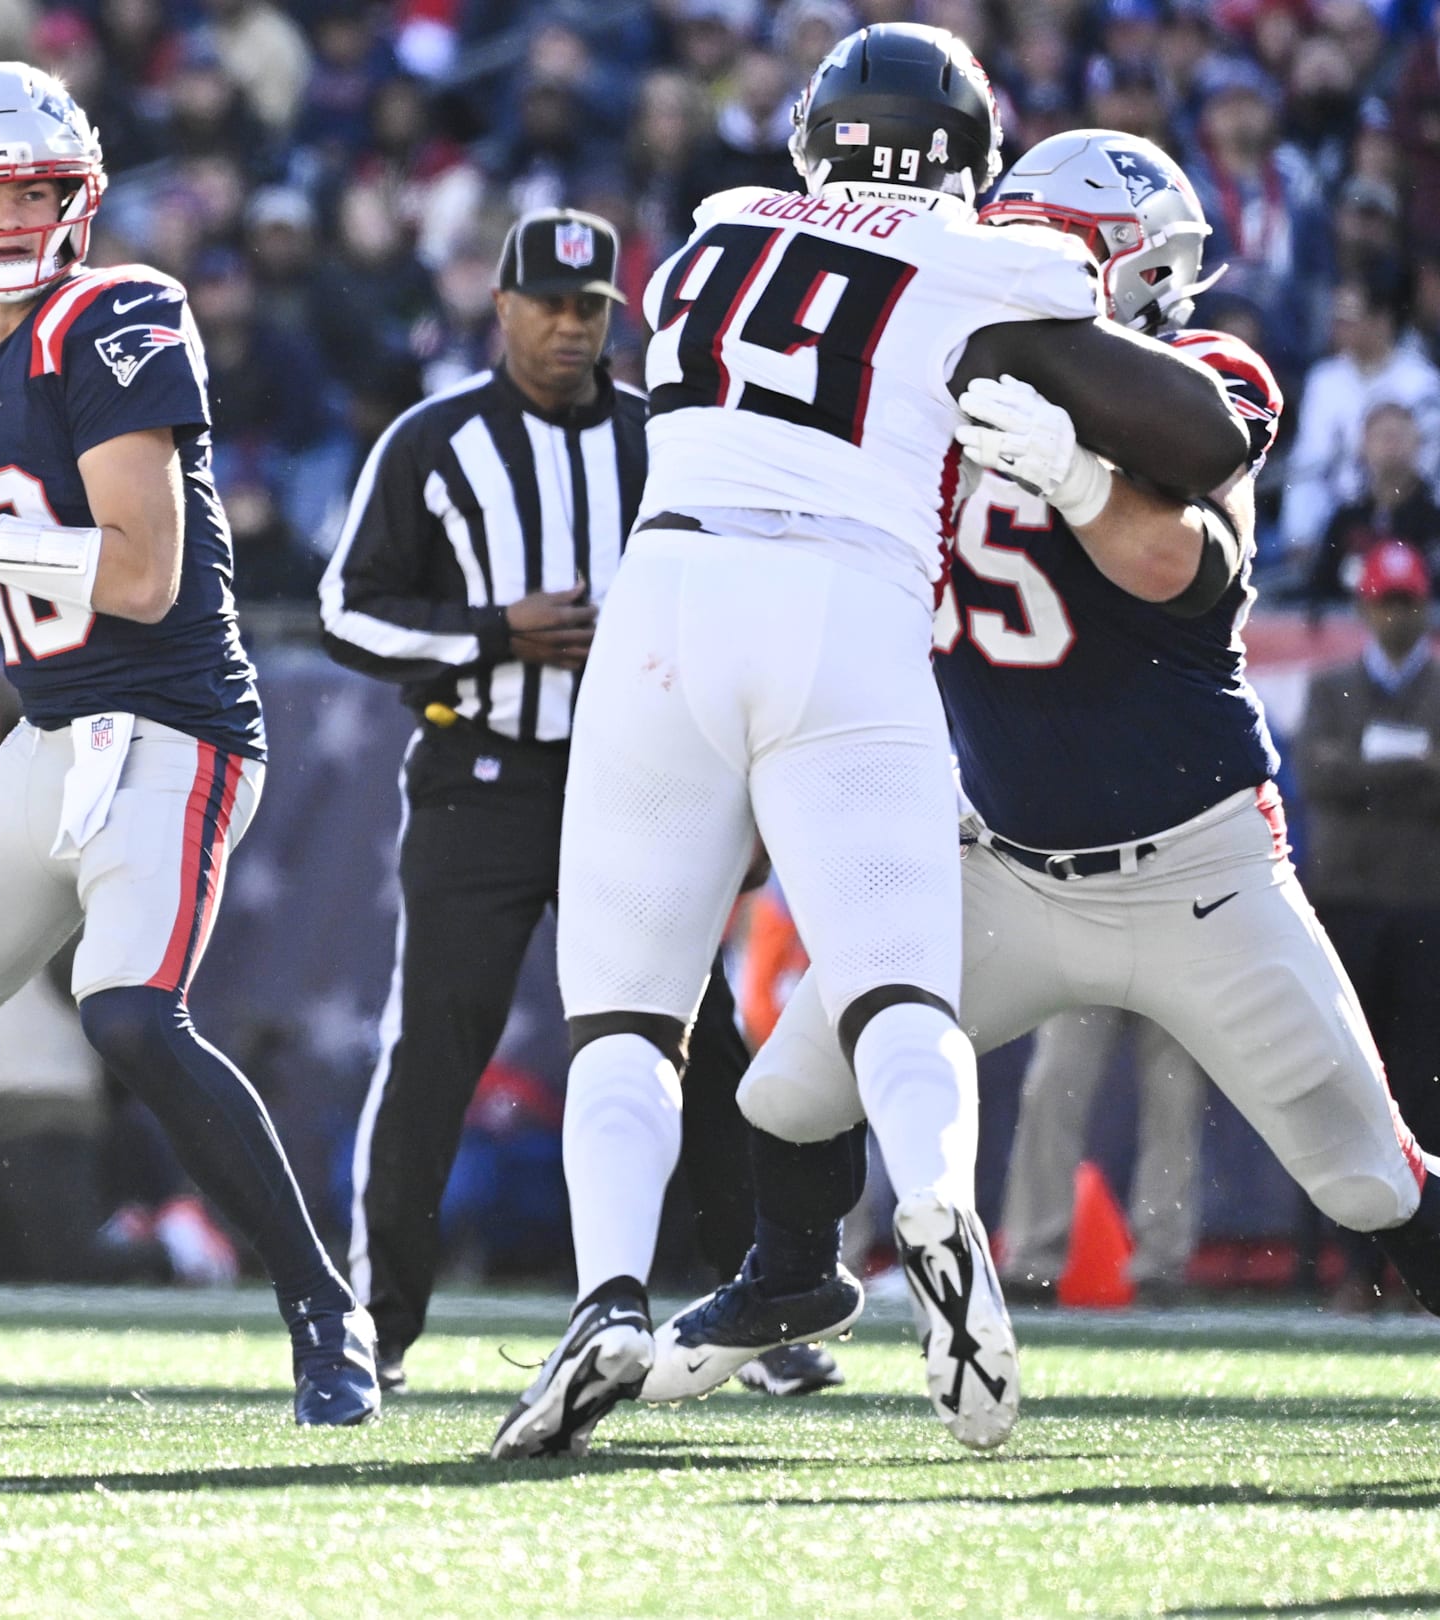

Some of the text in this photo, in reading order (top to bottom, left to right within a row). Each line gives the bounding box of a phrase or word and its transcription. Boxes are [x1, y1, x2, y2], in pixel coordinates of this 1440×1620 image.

[857, 190, 928, 204] FALCONS
[871, 146, 921, 182] 99
[648, 222, 919, 449] 99
[929, 466, 1078, 669] 5
